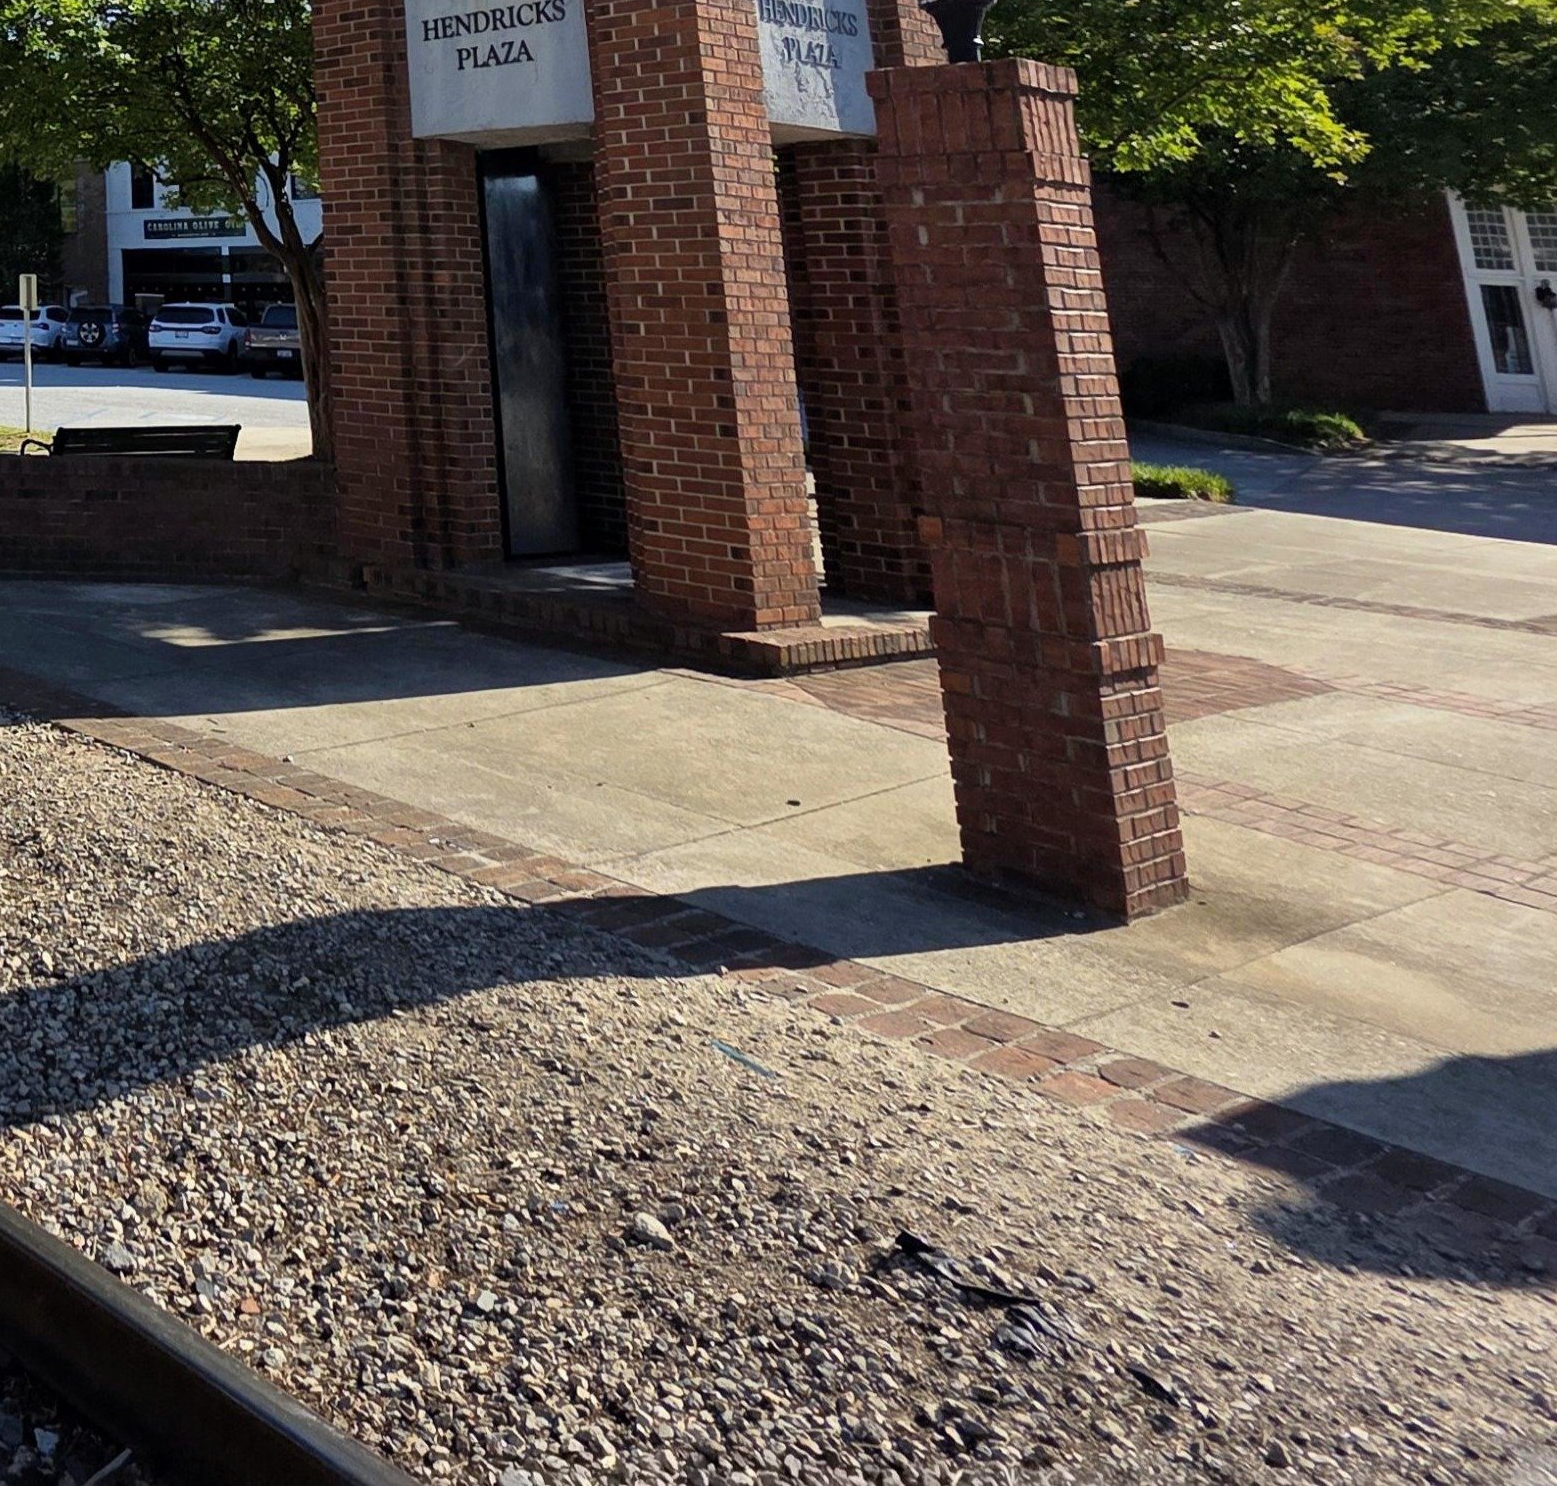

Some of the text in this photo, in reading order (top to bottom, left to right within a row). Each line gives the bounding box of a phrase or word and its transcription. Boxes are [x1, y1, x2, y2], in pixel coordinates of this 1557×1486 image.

[456, 39, 535, 70] PLAZA
[782, 37, 843, 70] PLAZA
[147, 221, 189, 232] CAROLINA
[192, 220, 219, 230] OLIVE
